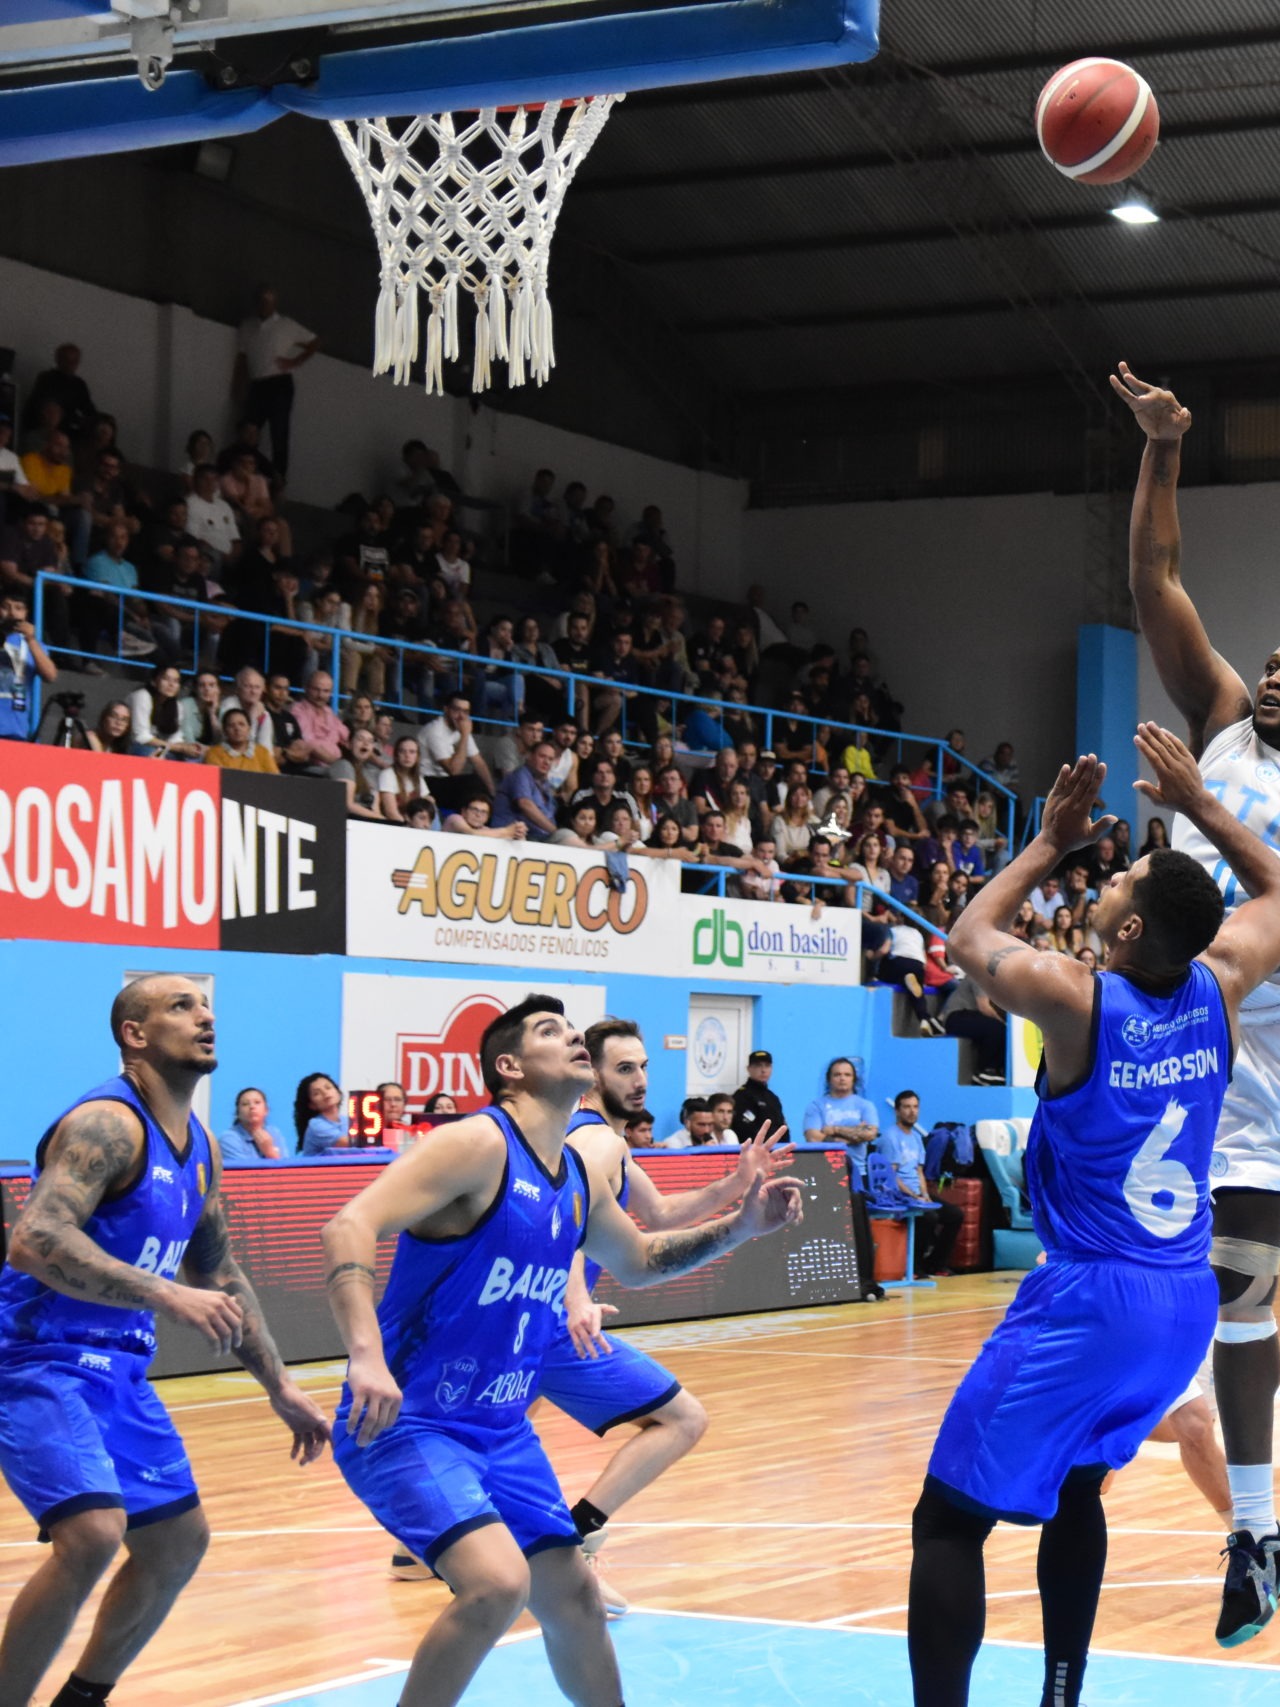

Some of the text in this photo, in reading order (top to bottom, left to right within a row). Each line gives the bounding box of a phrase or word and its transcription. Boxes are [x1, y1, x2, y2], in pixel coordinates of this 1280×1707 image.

[396, 845, 649, 935] AGUERCO
[434, 927, 609, 958] COMPENSADOS FENÓLICOS
[747, 921, 784, 952] don
[789, 923, 848, 957] basilio
[1109, 1046, 1219, 1090] GEMERSON
[1122, 1094, 1199, 1240] 6
[512, 1311, 531, 1355] 8
